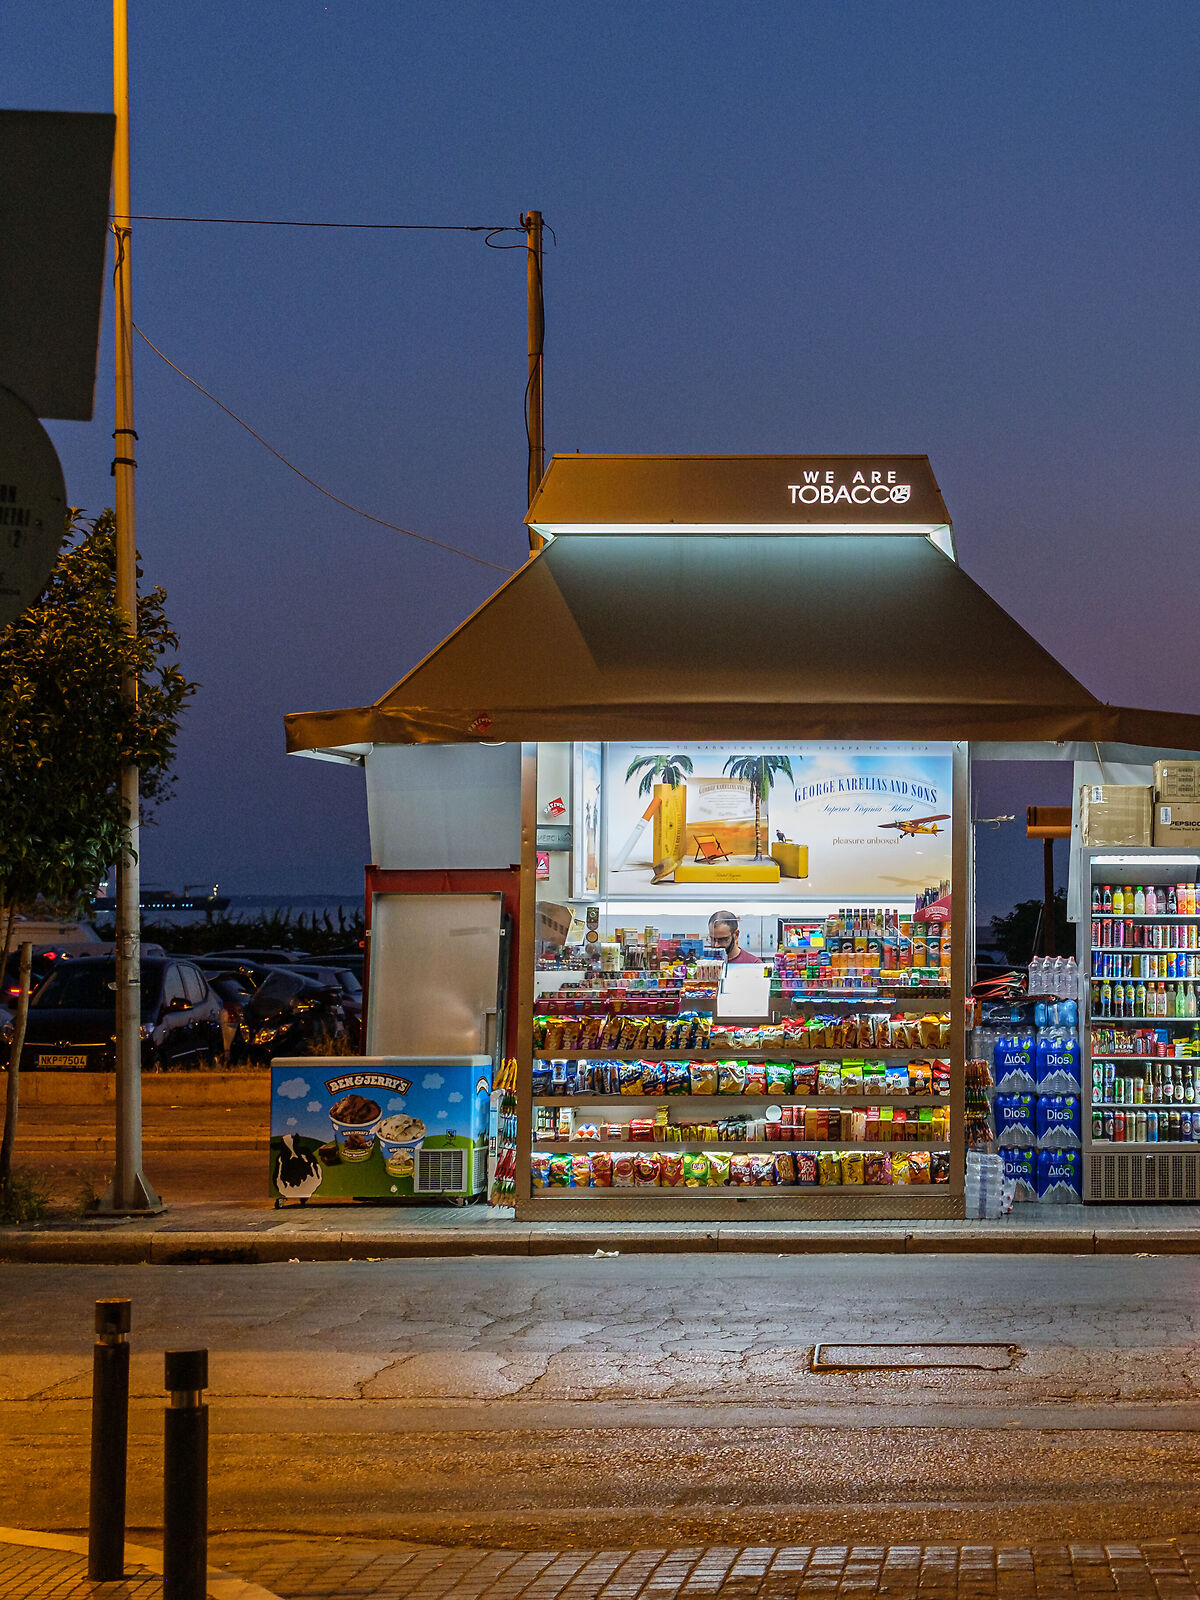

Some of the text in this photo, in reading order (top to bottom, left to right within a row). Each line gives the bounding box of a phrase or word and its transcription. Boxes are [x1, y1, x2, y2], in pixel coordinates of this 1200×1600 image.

[803, 471, 896, 484] WE ARE
[787, 485, 911, 504] TOBACCO
[794, 777, 937, 804] GEORGE KARELIAS AND SONS
[853, 804, 883, 816] Virginia
[889, 803, 914, 813] Blend
[832, 836, 900, 846] pleasure unboxed
[1004, 1053, 1026, 1066] Διός
[1047, 1053, 1070, 1065] Dios
[1003, 1107, 1026, 1119] Dios
[1047, 1108, 1070, 1120] Dios
[1006, 1163, 1028, 1174] Dios
[1048, 1165, 1070, 1177] Διός
